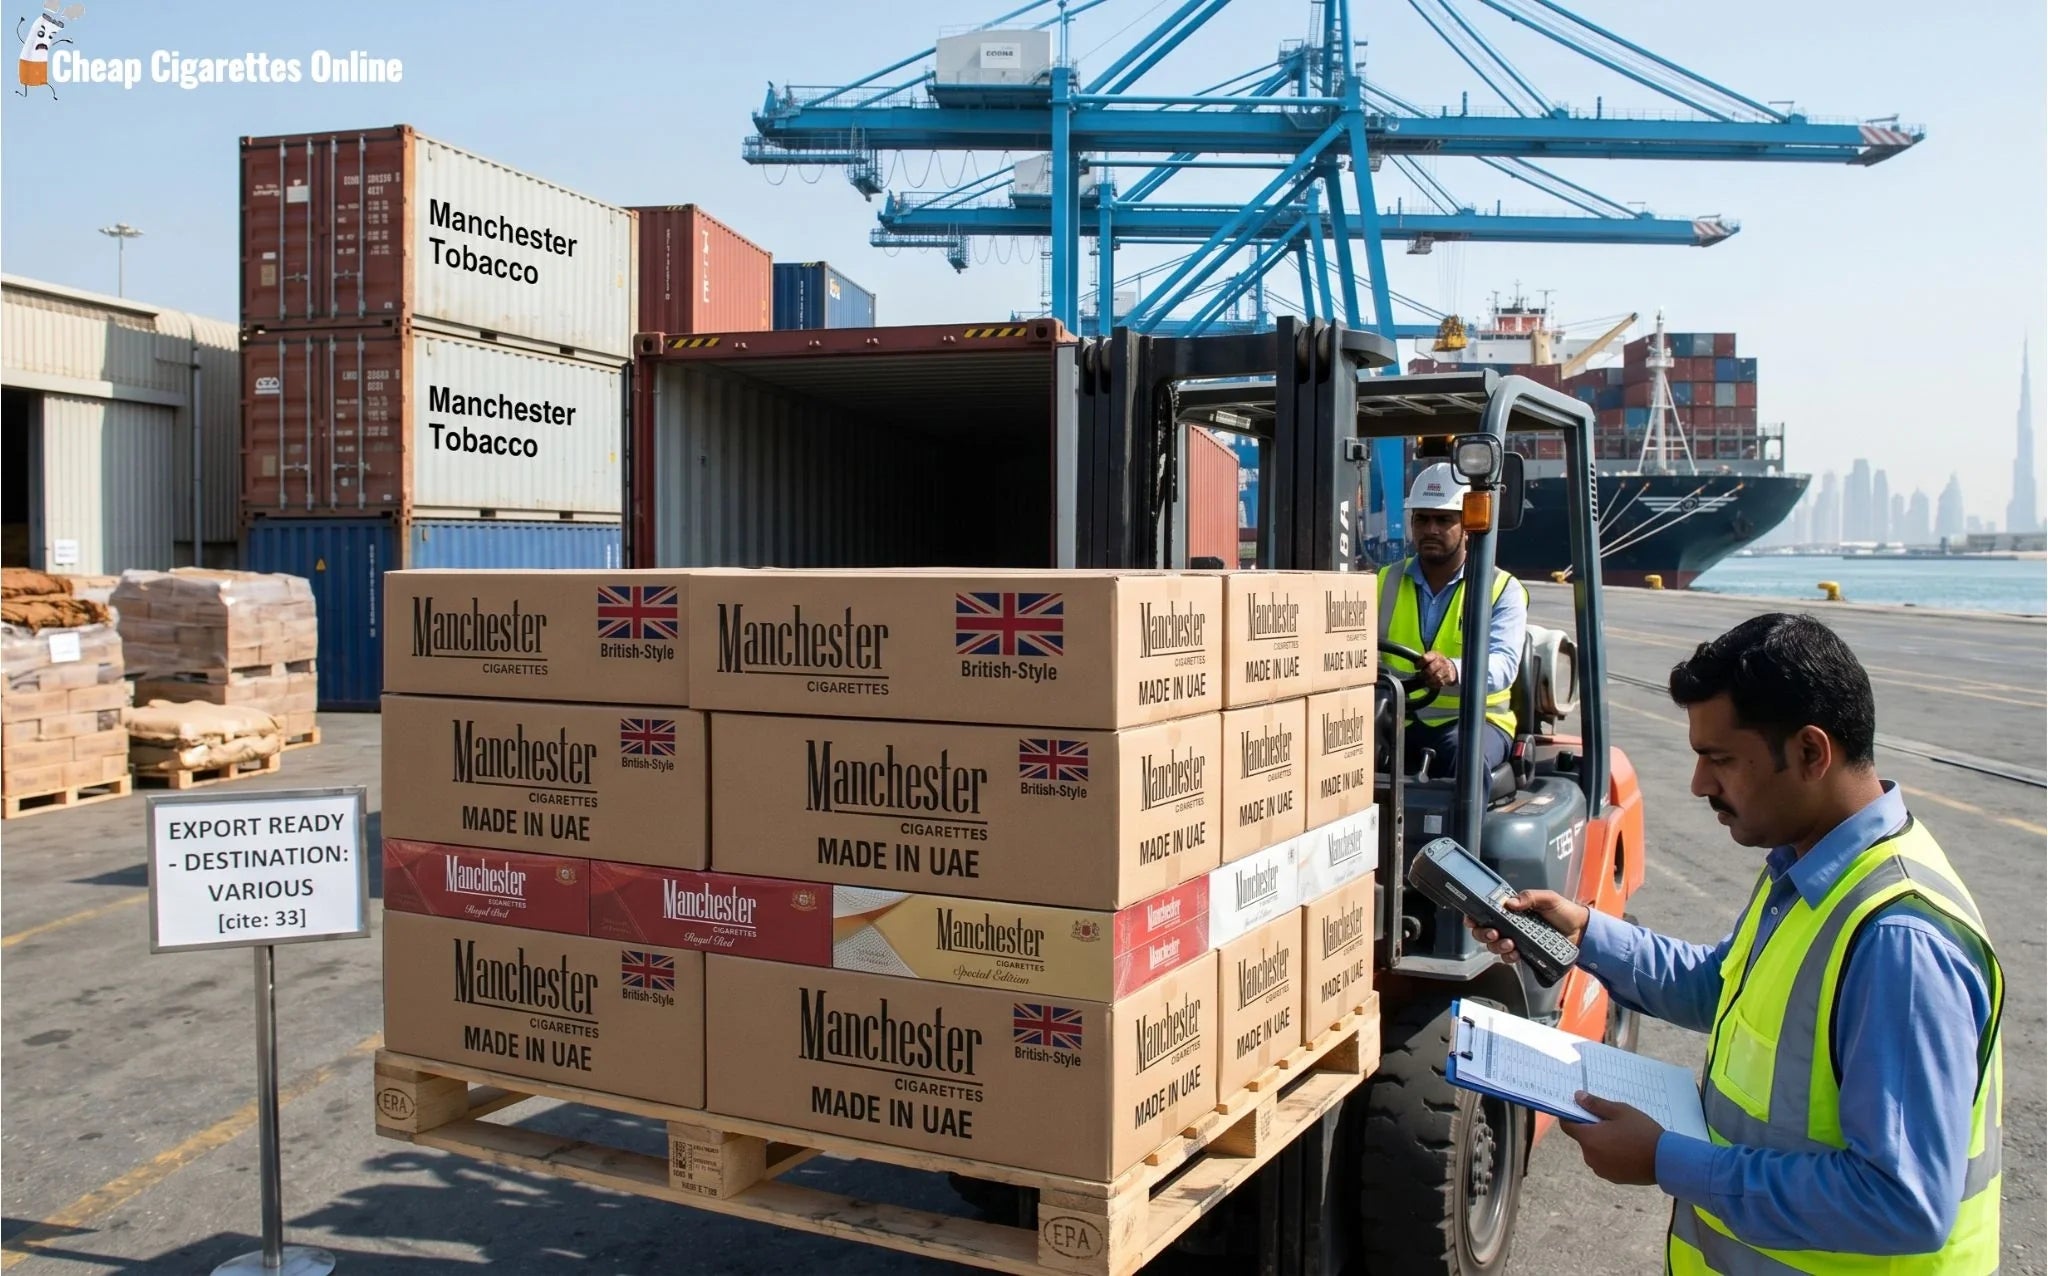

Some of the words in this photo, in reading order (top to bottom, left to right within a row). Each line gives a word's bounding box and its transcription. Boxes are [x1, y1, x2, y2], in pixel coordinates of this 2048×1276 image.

[429, 197, 578, 258] Manchester
[429, 236, 539, 284] Tobacco
[429, 384, 576, 427] Manchester
[429, 423, 538, 458] Tobacco
[412, 596, 548, 657] Manchester
[1140, 601, 1205, 658] Manchester
[1248, 592, 1299, 641] Manchester
[1325, 590, 1367, 634] Manchester
[601, 643, 674, 662] British-Style
[717, 603, 889, 673] Manchester
[483, 663, 548, 675] CIGARETTES
[961, 660, 1057, 683] British-Style
[1246, 661, 1271, 683] MADE
[1273, 658, 1282, 679] IN
[1283, 656, 1299, 678] UAE
[1323, 653, 1345, 672] MADE
[1346, 651, 1353, 670] IN
[1354, 649, 1367, 668] UAE
[807, 681, 889, 695] CIGARETTES
[1139, 677, 1170, 706] MADE
[1173, 675, 1184, 700] IN
[1187, 672, 1206, 698] UAE
[452, 719, 598, 784] Manchester
[1241, 723, 1292, 779] Manchester
[1322, 708, 1364, 756] Manchester
[805, 740, 987, 814] Manchester
[1020, 782, 1087, 800] British-Style
[1141, 746, 1205, 811] Manchester
[1321, 776, 1342, 798] MADE
[1342, 772, 1350, 790] IN
[1351, 768, 1364, 787] UAE
[529, 792, 598, 808] CIGARETTES
[1240, 799, 1264, 827] MADE
[1266, 795, 1275, 817] IN
[1276, 790, 1293, 813] UAE
[169, 817, 261, 840] EXPORT
[268, 813, 344, 835] READY
[462, 805, 517, 834] MADE
[524, 811, 543, 837] IN
[551, 814, 590, 841] UAE
[900, 823, 988, 841] CIGARETTES
[184, 845, 349, 872] DESTINATION:
[817, 837, 887, 869] MADE
[895, 843, 920, 872] IN
[929, 846, 979, 878] UAE
[1140, 833, 1170, 866] MADE
[1173, 827, 1183, 851] IN
[1186, 822, 1205, 847] UAE
[209, 878, 314, 902] VARIOUS
[445, 855, 526, 896] Manchester
[218, 913, 269, 933] [cite:
[275, 909, 306, 928] 33]
[663, 879, 756, 923] Manchester
[713, 926, 756, 937] CIGARETTES
[936, 908, 1044, 956] Manchester
[1322, 901, 1363, 960] Manchester
[454, 939, 598, 1015] Manchester
[953, 965, 990, 980] Special
[996, 960, 1045, 972] CIGARETTES
[1237, 941, 1289, 1011] Manchester
[1321, 976, 1341, 1003] MADE
[1343, 970, 1350, 991] IN
[1351, 959, 1363, 985] UAE
[622, 988, 674, 1007] British-Style
[464, 1026, 519, 1059] MADE
[526, 1036, 544, 1063] IN
[552, 1041, 592, 1072] UAE
[530, 1019, 599, 1038] CIGARETTES
[799, 988, 983, 1076] Manchester
[1135, 992, 1200, 1075] Manchester
[1236, 1025, 1261, 1060] MADE
[1263, 1017, 1272, 1041] IN
[1274, 1007, 1290, 1033] UAE
[1014, 1047, 1081, 1067] British-Style
[895, 1078, 983, 1102] CIGARETTES
[1135, 1090, 1166, 1130] MADE
[1169, 1077, 1179, 1102] IN
[1182, 1064, 1201, 1098] UAE
[812, 1086, 880, 1124] MADE
[889, 1100, 913, 1129] IN
[923, 1105, 973, 1139] UAE
